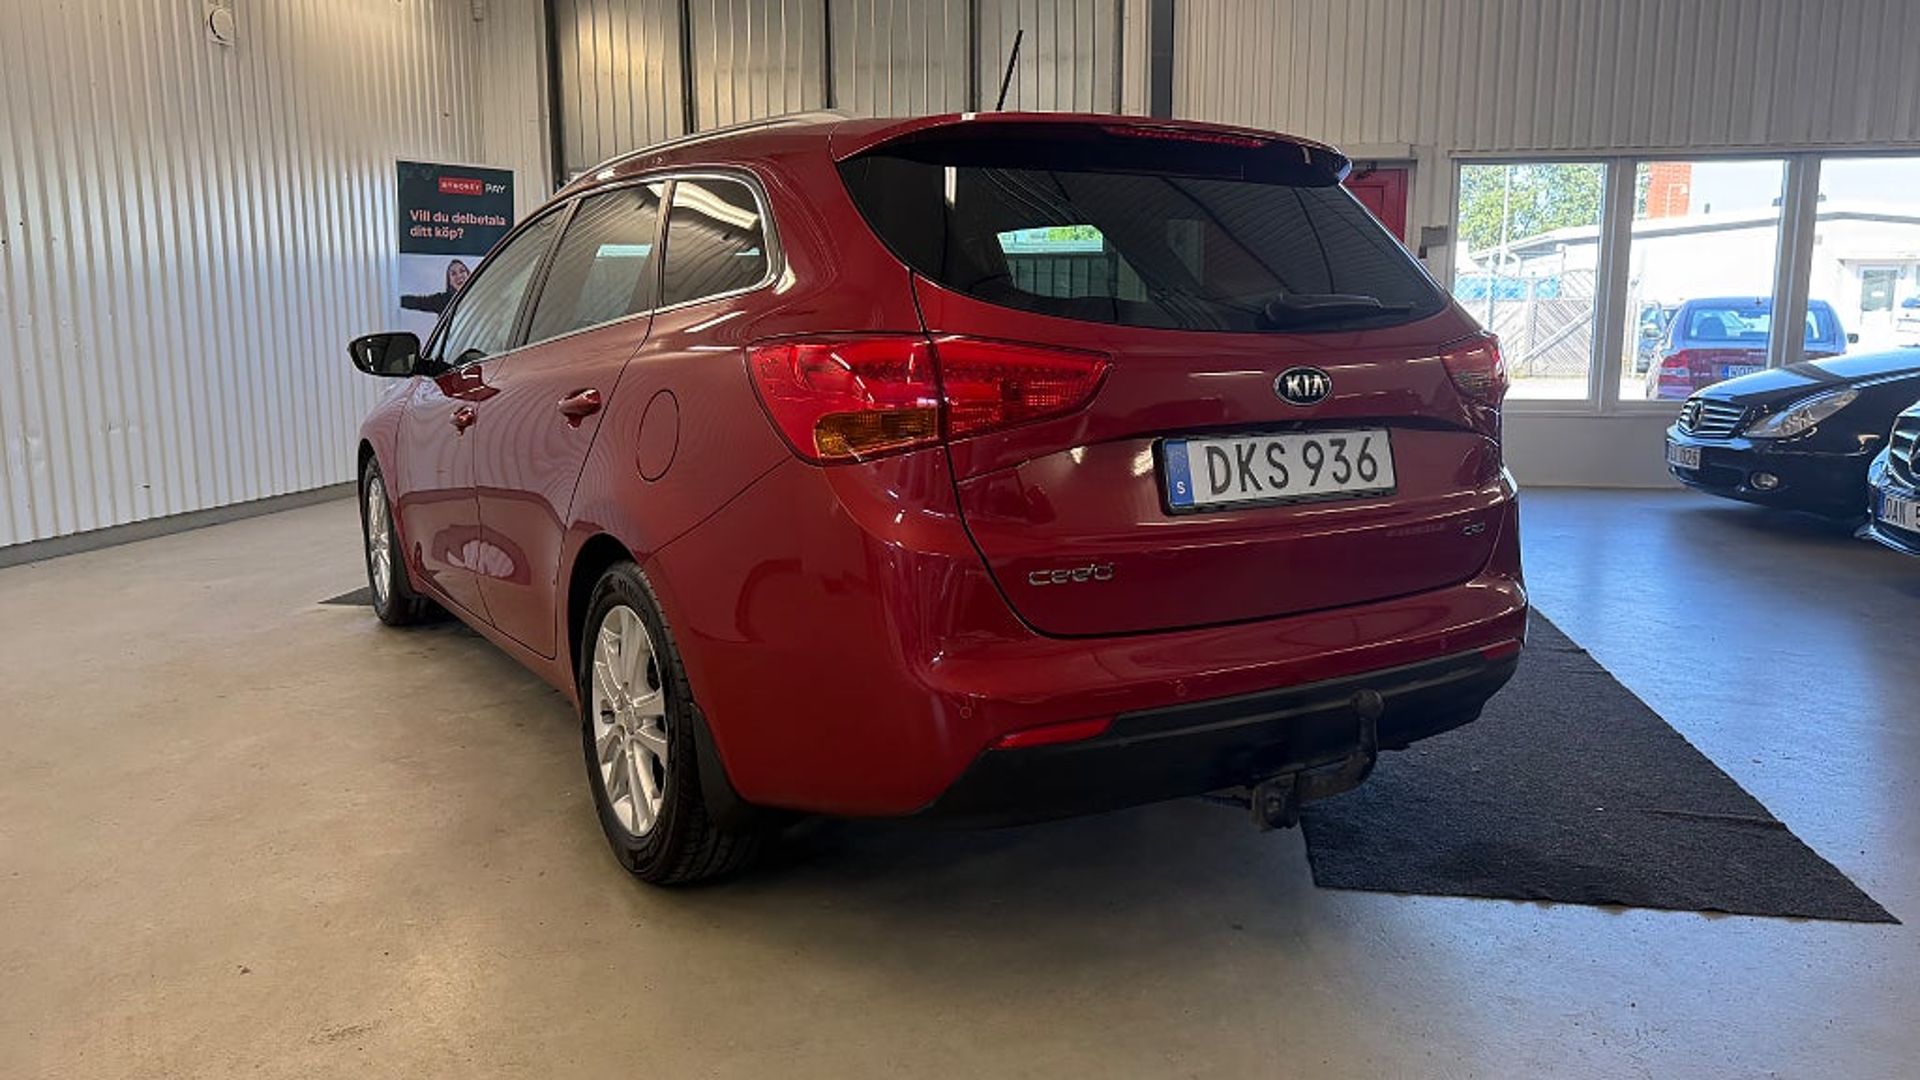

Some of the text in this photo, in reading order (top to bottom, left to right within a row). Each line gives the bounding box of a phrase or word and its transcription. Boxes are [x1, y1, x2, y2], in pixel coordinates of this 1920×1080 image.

[485, 183, 506, 194] PAY
[409, 209, 506, 226] Vill du delbetala
[409, 226, 464, 240] ditt köp?
[1286, 375, 1327, 397] KIA
[1206, 436, 1378, 496] DKS 936
[1176, 481, 1186, 494] S
